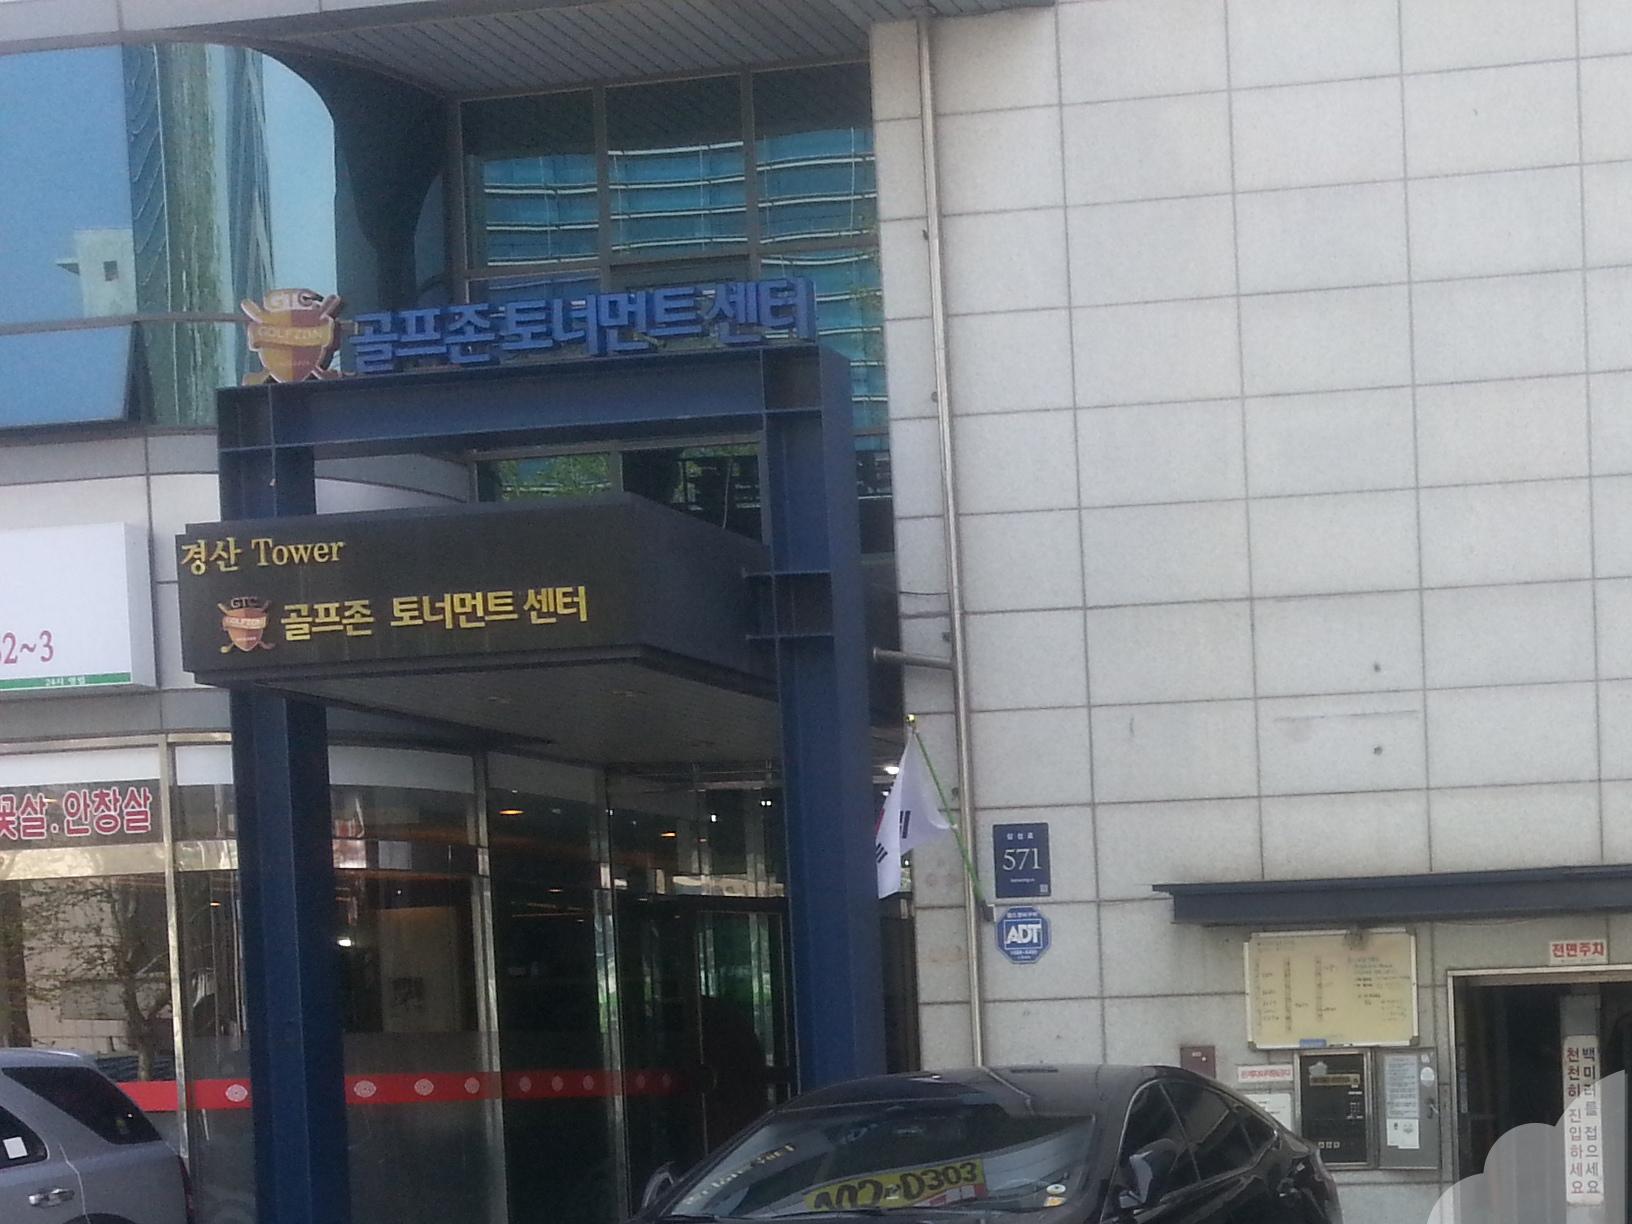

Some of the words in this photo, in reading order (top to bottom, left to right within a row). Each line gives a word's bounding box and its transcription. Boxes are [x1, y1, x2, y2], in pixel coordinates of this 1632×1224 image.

[181, 537, 243, 576] 경산
[251, 536, 346, 567] Tower
[281, 599, 375, 641] 골프존
[390, 591, 519, 630] 토너먼트
[523, 585, 588, 625] 센터
[1002, 848, 1042, 871] 571
[1005, 924, 1042, 945] ADT
[1551, 941, 1604, 958] 전면주차
[1567, 1047, 1581, 1098] 천천히
[1568, 1108, 1584, 1194] 진입하세요
[1584, 1125, 1601, 1194] 접으세요
